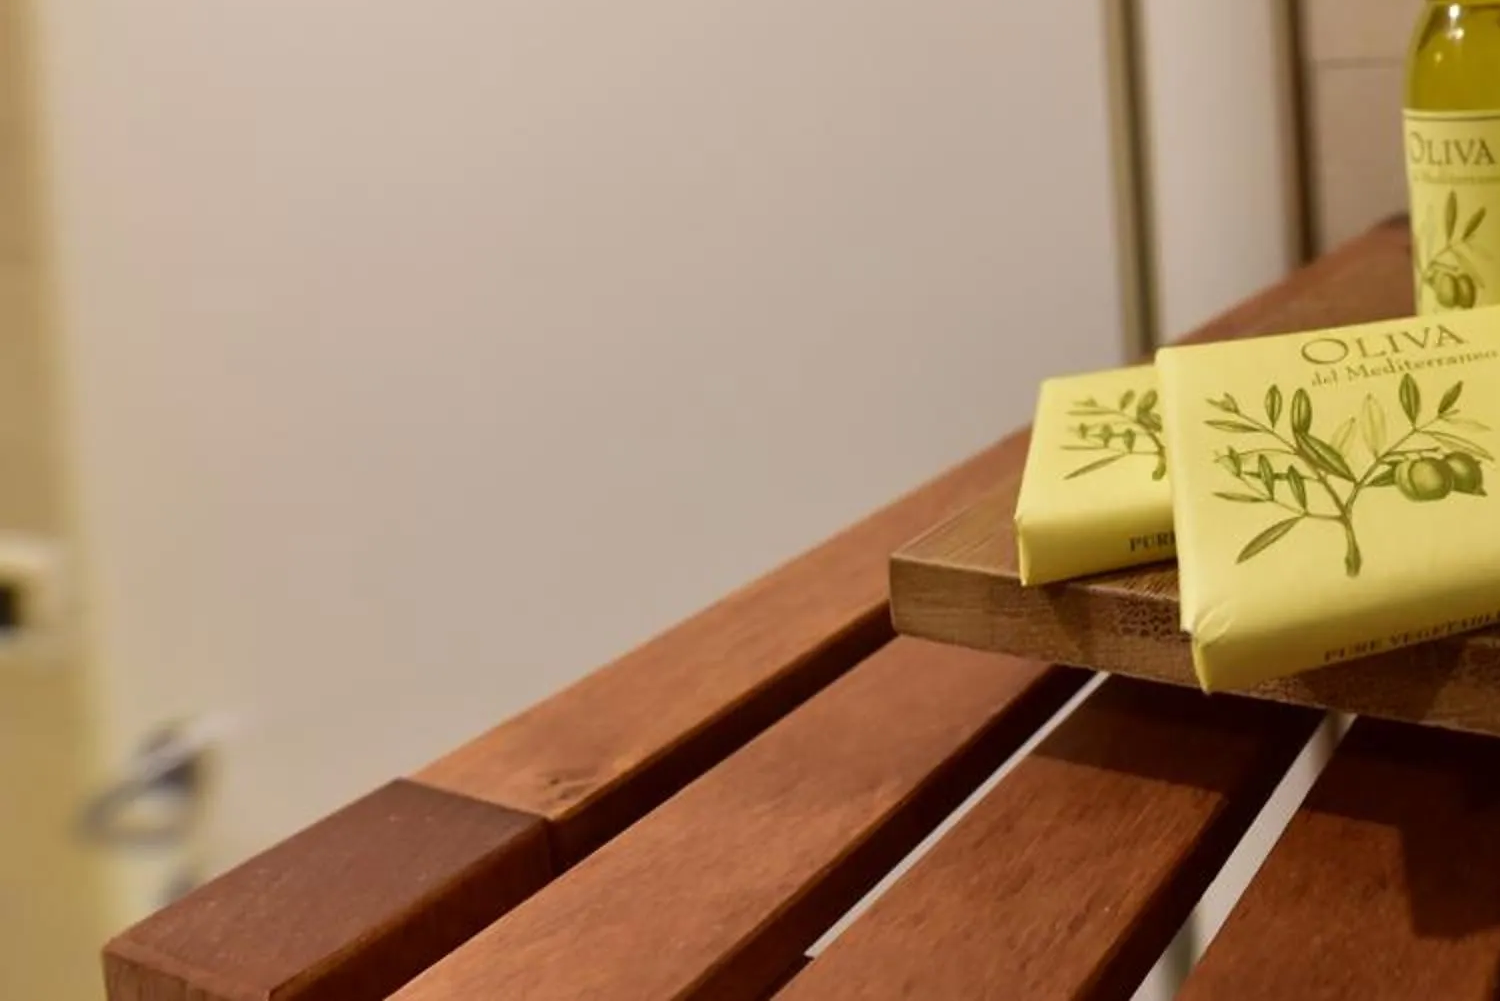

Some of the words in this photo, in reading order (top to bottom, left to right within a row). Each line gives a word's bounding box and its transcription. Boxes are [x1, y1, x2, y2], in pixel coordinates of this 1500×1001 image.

[1409, 131, 1496, 166] OLIVA
[1301, 324, 1466, 365] OLIVA
[1312, 369, 1338, 387] del
[1345, 349, 1499, 380] Mediterraneo
